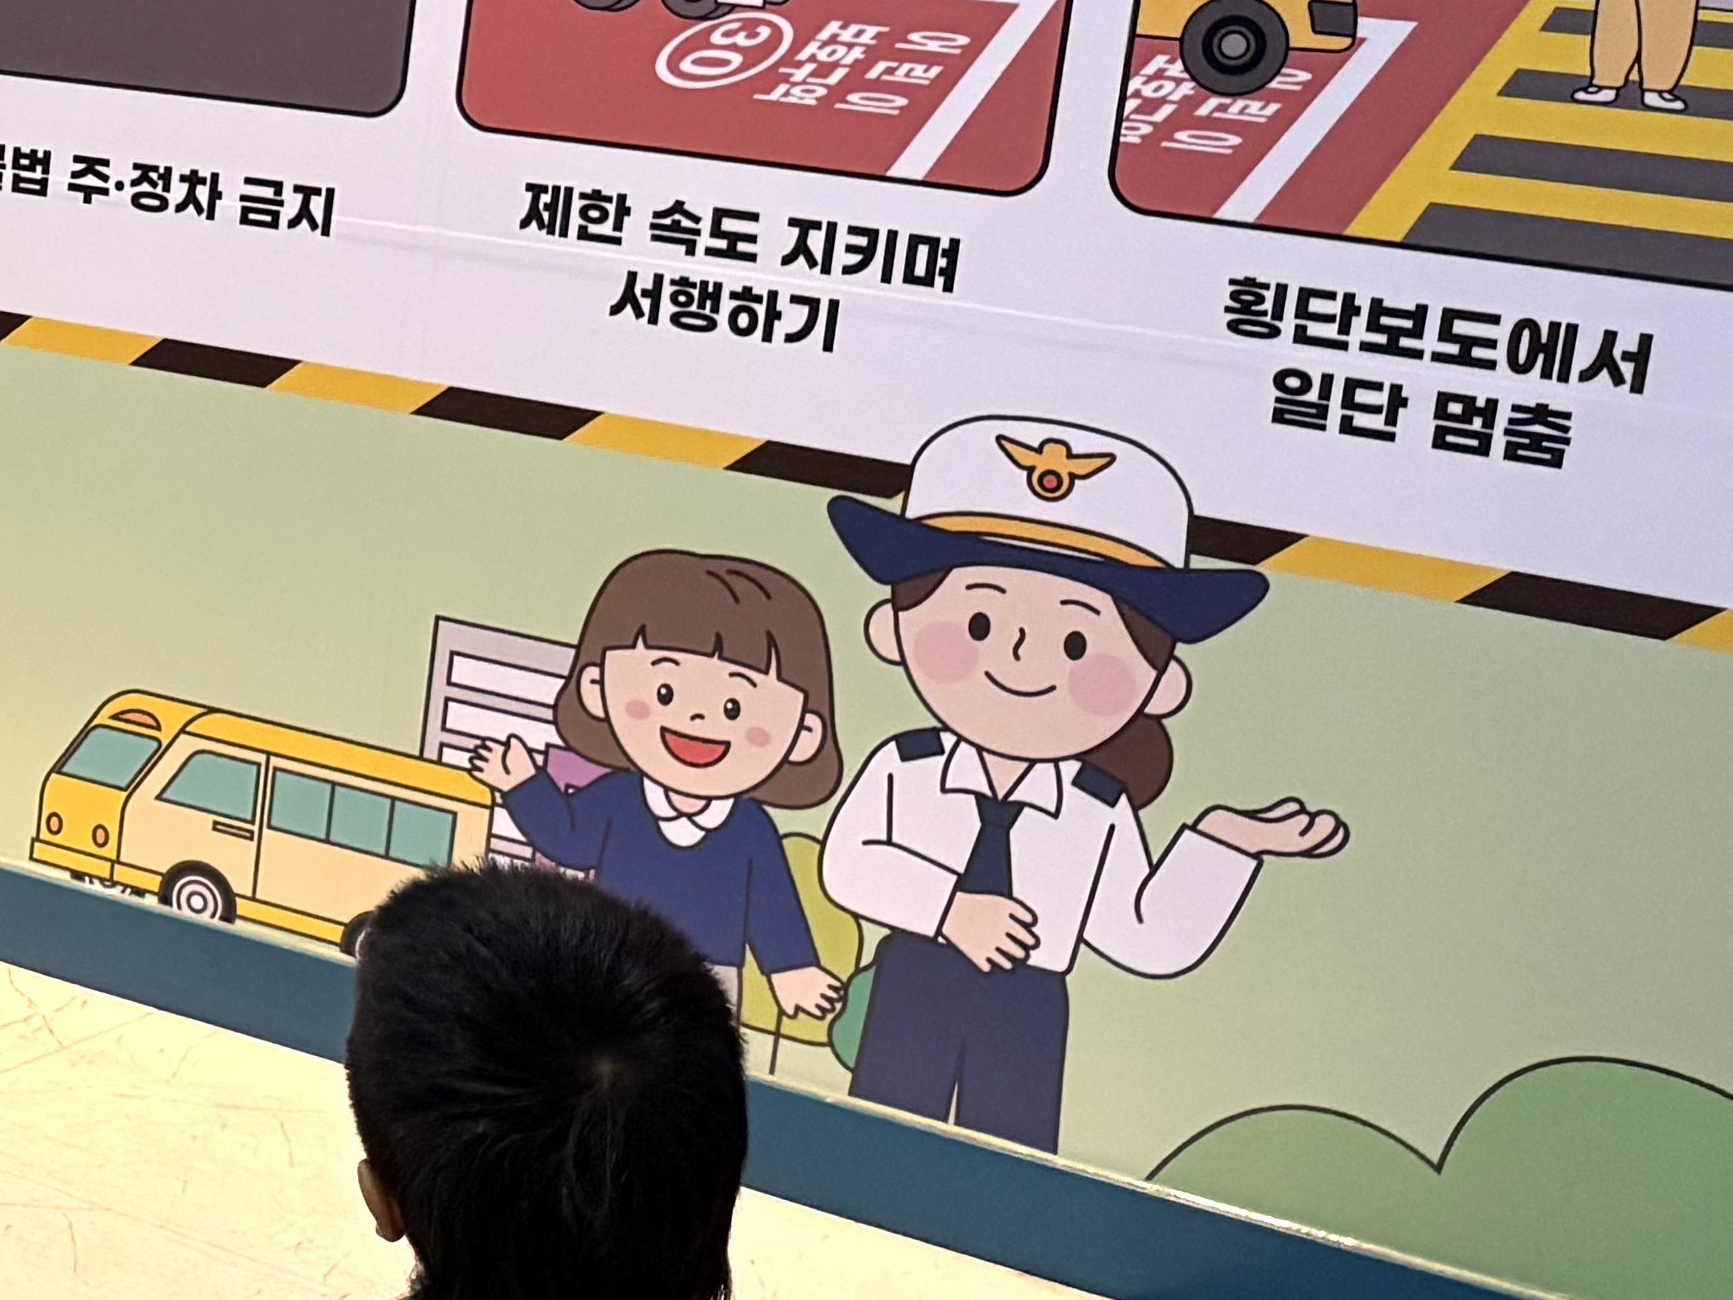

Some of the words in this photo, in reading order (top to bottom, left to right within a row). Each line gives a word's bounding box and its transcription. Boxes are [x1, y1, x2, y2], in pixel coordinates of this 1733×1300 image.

[67, 153, 224, 222] 주·정차
[238, 177, 336, 238] 금지
[518, 181, 631, 246] 제한
[648, 198, 763, 266] 속도
[779, 215, 962, 295] 지키며
[607, 270, 840, 354] 서행하기
[1223, 274, 1654, 395] 횡단보도에서
[1270, 367, 1408, 443] 일단
[1429, 392, 1576, 470] 멈춤
